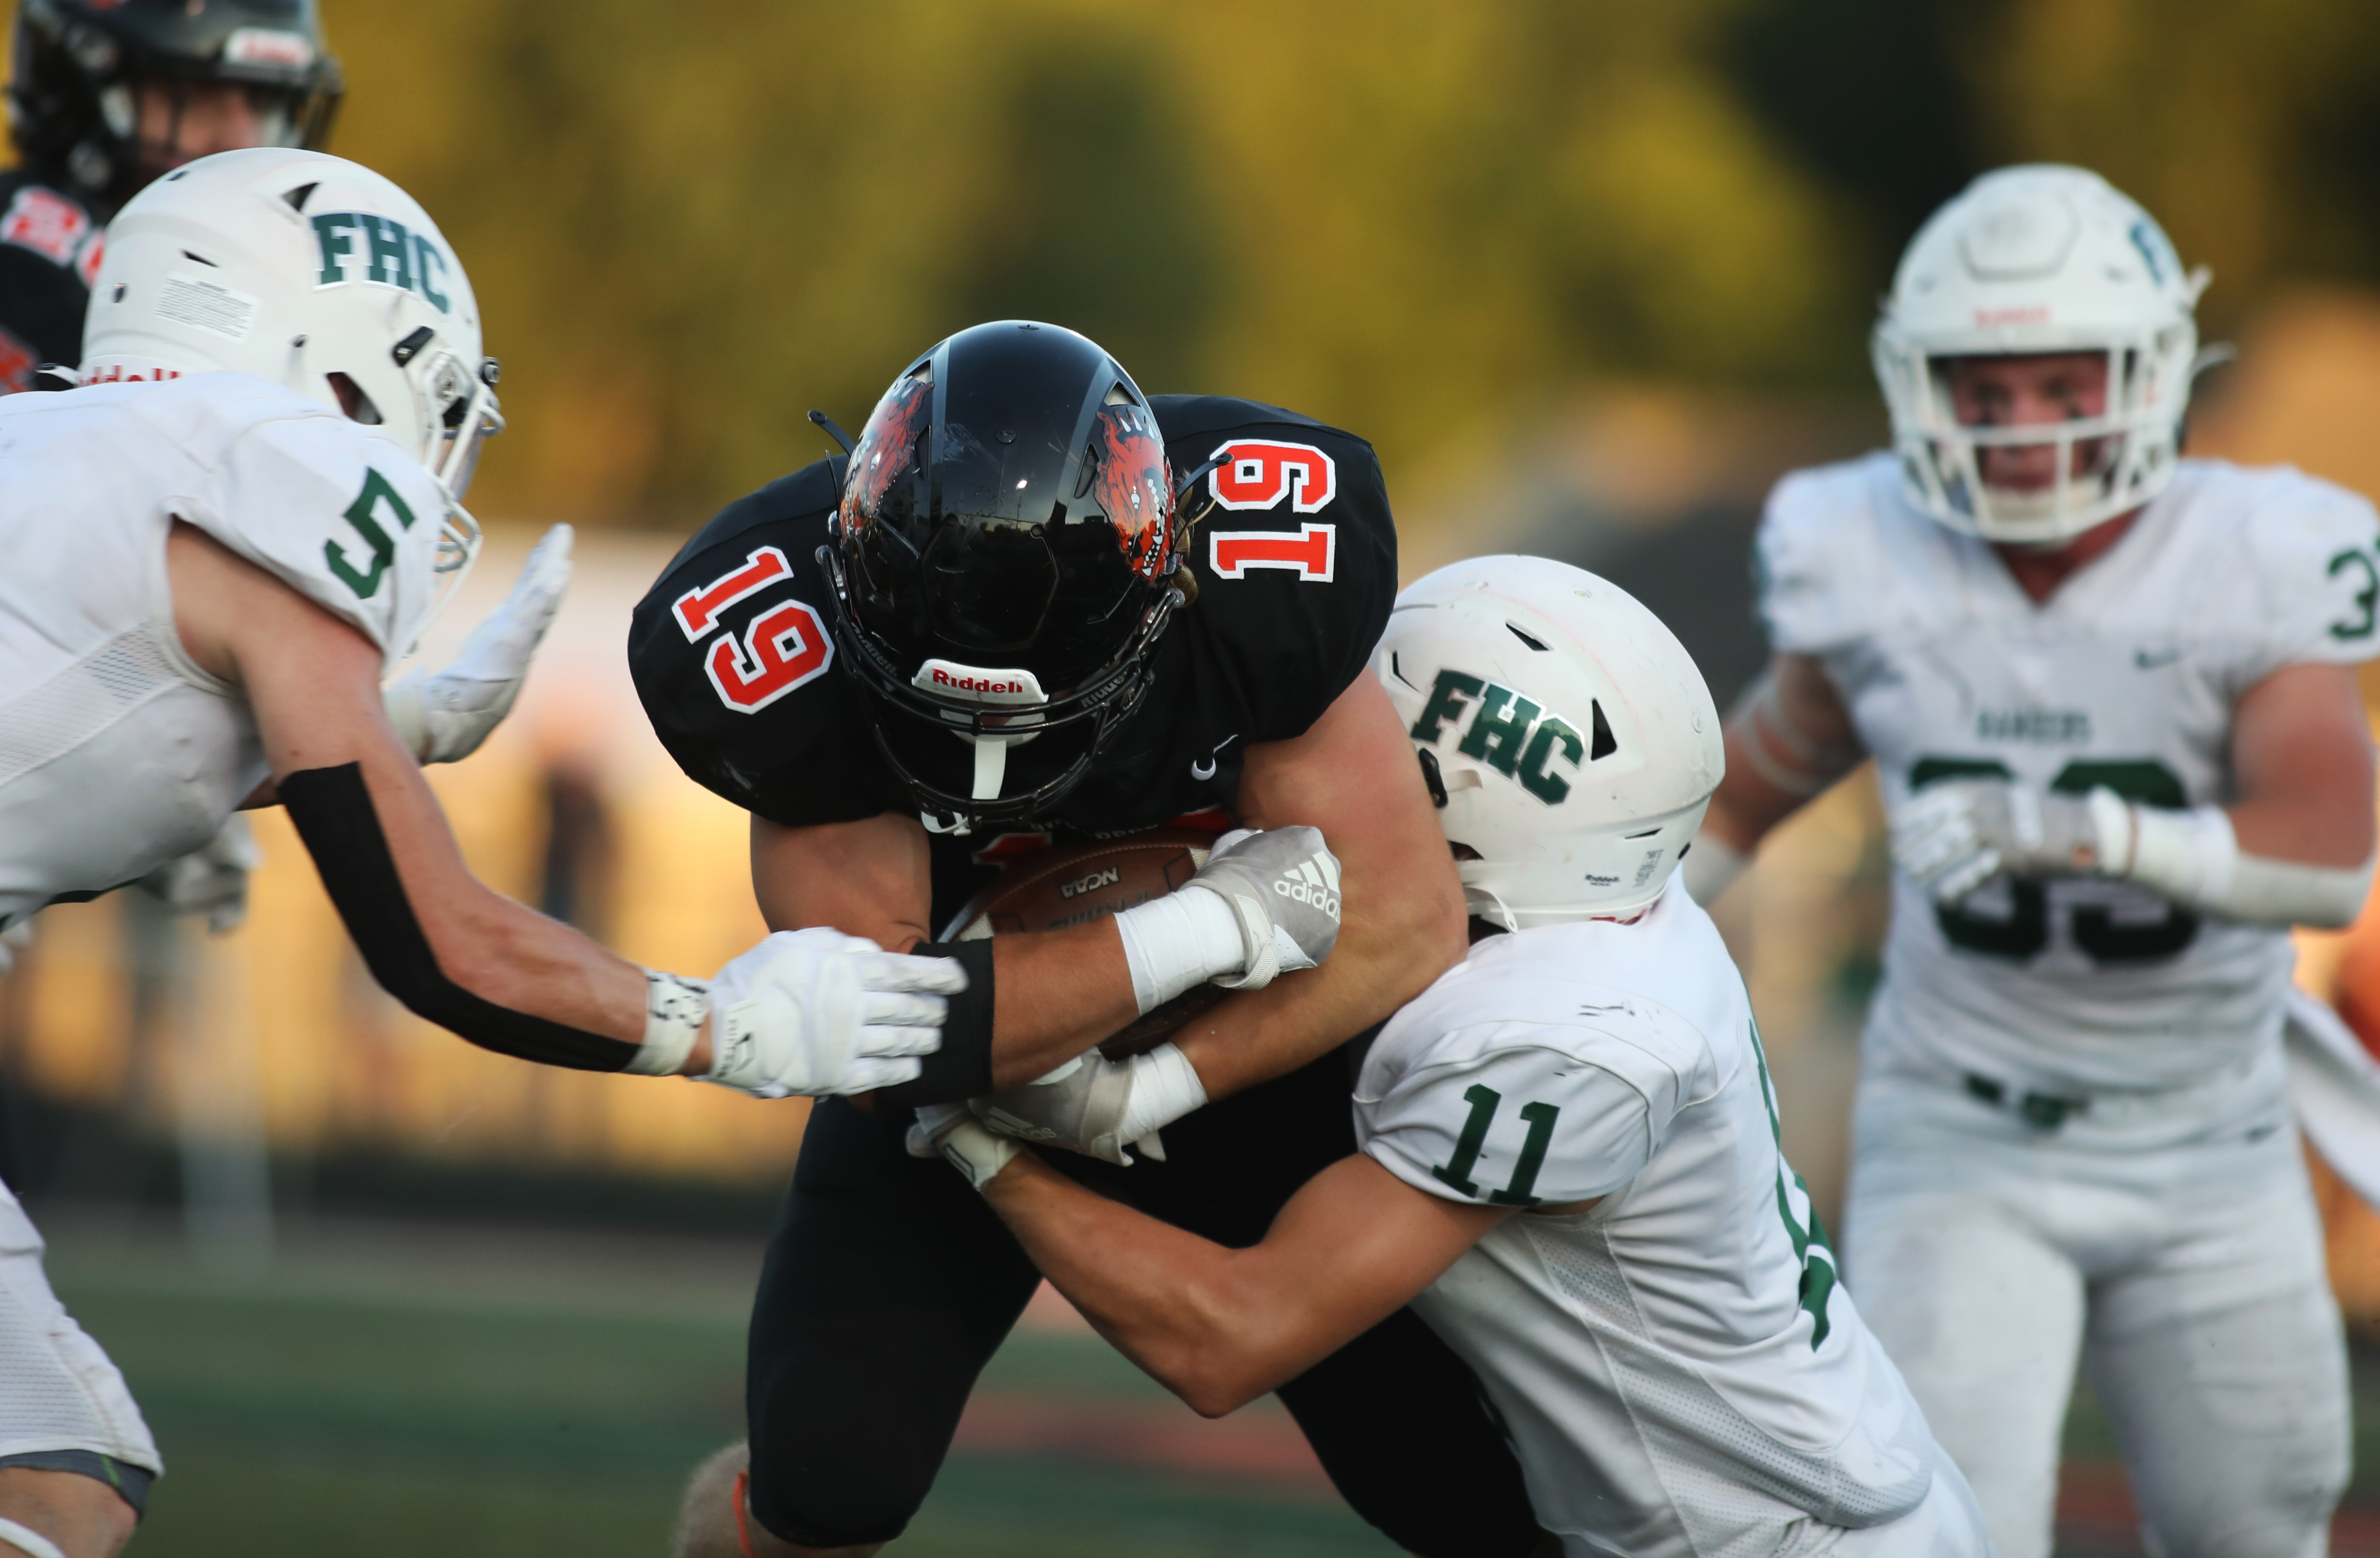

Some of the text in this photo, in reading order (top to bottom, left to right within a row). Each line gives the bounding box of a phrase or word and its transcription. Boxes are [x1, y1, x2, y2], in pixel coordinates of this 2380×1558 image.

[310, 211, 451, 316] FHC
[323, 465, 419, 600] 5
[1209, 439, 1336, 583] 19
[671, 545, 836, 715] 19
[2326, 548, 2380, 640] 3
[933, 668, 1024, 693] Riddell
[1410, 668, 1588, 807] FHC
[1060, 867, 1119, 899] NCAA
[1431, 1083, 1561, 1207] 11
